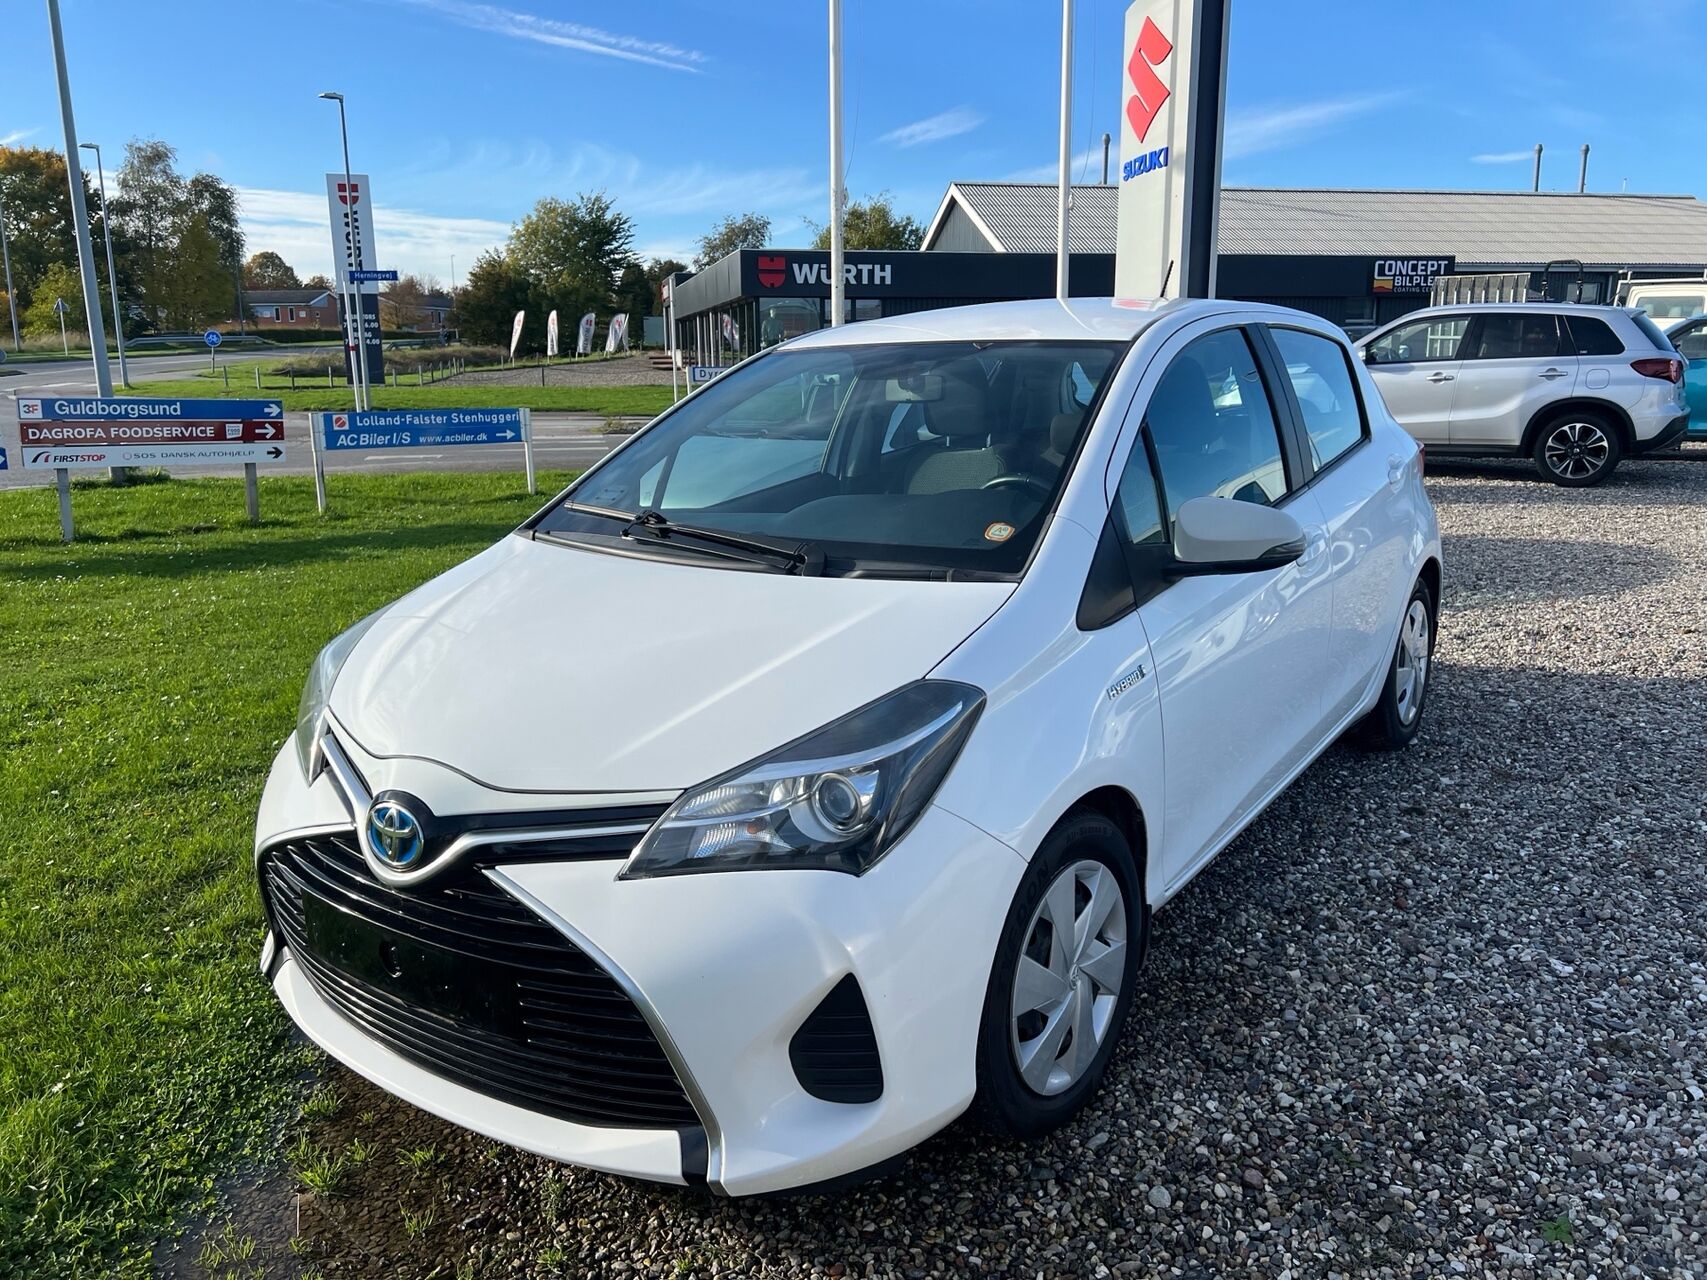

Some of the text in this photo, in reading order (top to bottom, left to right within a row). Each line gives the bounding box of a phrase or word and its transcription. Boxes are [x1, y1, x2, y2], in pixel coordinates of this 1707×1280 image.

[1123, 147, 1169, 182] SUZUKI
[354, 272, 393, 280] Herningvej
[1374, 260, 1449, 279] CONCEPT
[700, 369, 725, 380] Dyr
[22, 400, 181, 418] 3F Guldborgsund
[356, 411, 520, 426] Lolland-Falster Stenhuggeri
[27, 426, 215, 440] DAGROFA FOODSERVICE
[336, 431, 488, 447] AC Biler I/S www.acbiler.dk
[53, 453, 106, 463] FIRSTSTOP
[1106, 668, 1141, 701] HYBRID
